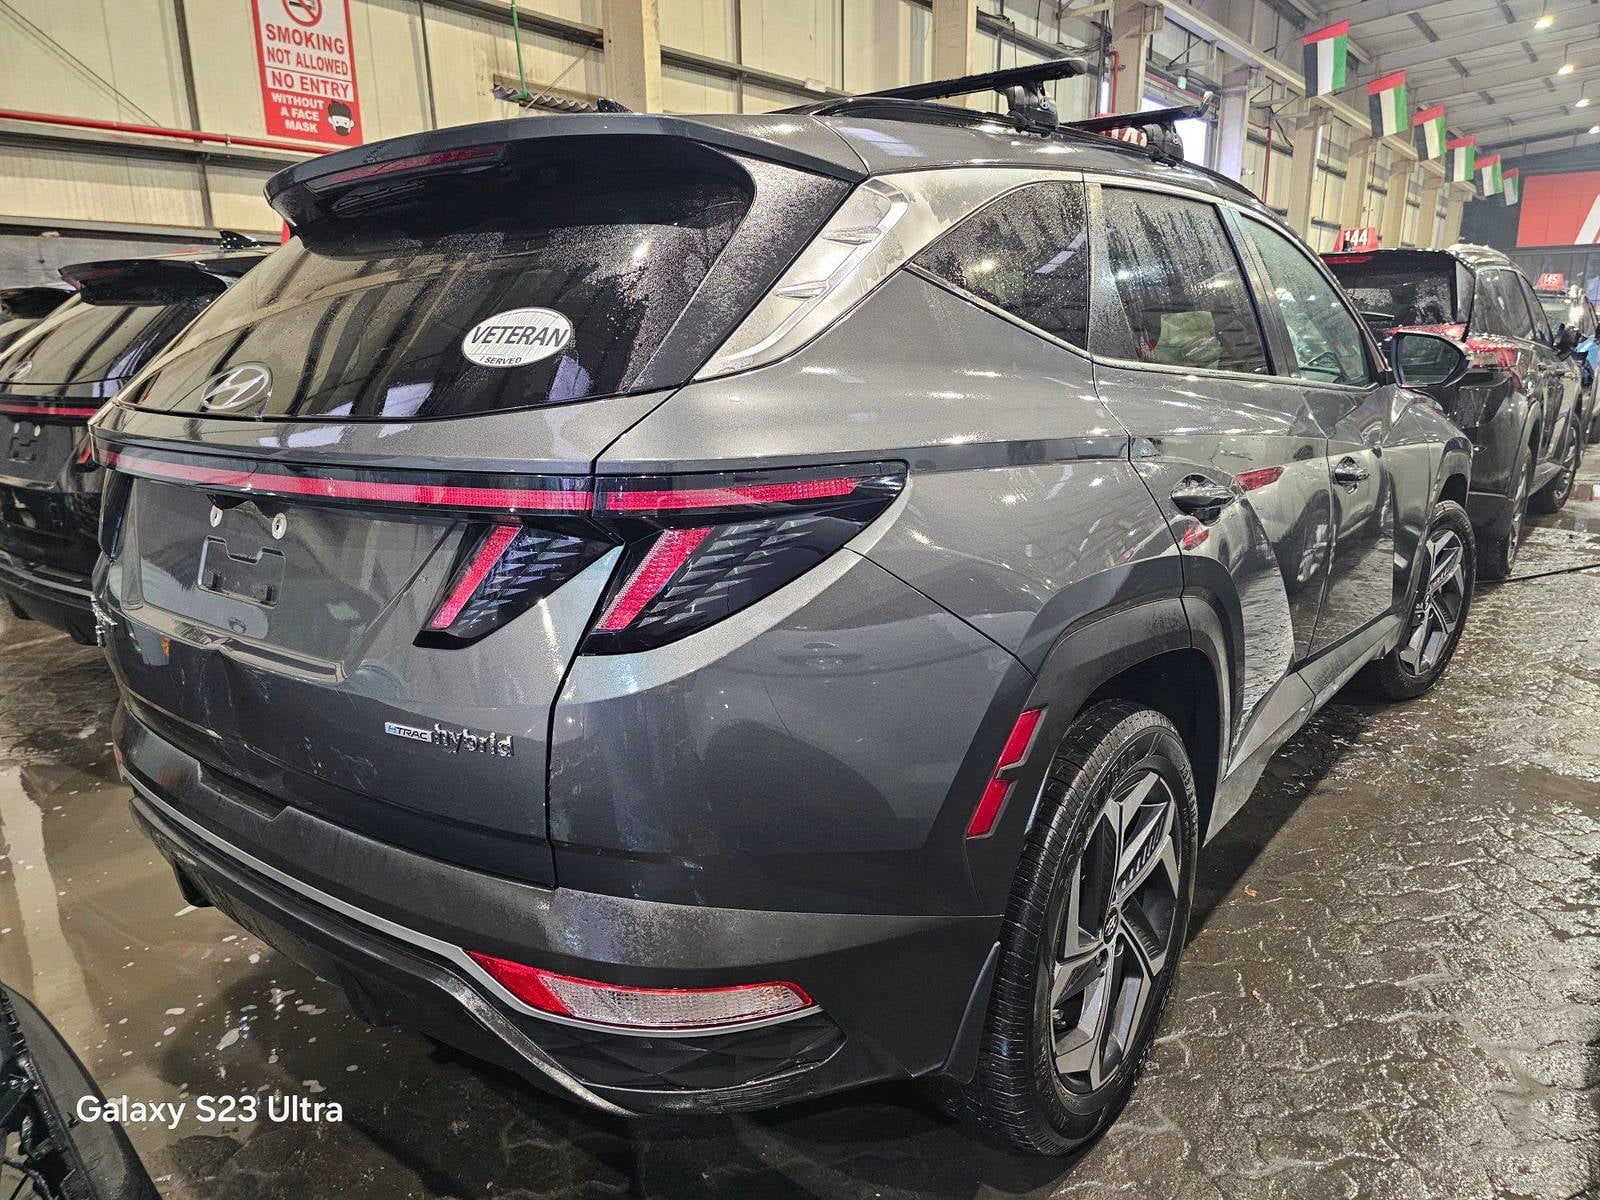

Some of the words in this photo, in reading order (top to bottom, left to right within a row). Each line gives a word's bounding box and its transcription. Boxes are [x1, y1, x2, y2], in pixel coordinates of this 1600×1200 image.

[265, 23, 345, 55] SMOKING
[266, 46, 291, 65] NOT
[296, 52, 348, 76] ALLOWED
[271, 70, 295, 89] NO
[300, 75, 350, 99] ENTRY
[271, 92, 325, 110] WITHOUT
[280, 107, 290, 117] A
[291, 108, 321, 121] FACE
[284, 119, 319, 133] MASK
[1344, 229, 1369, 246] 144
[471, 325, 569, 347] VETERAN
[484, 356, 522, 364] SERVED
[430, 723, 514, 757] hybrid
